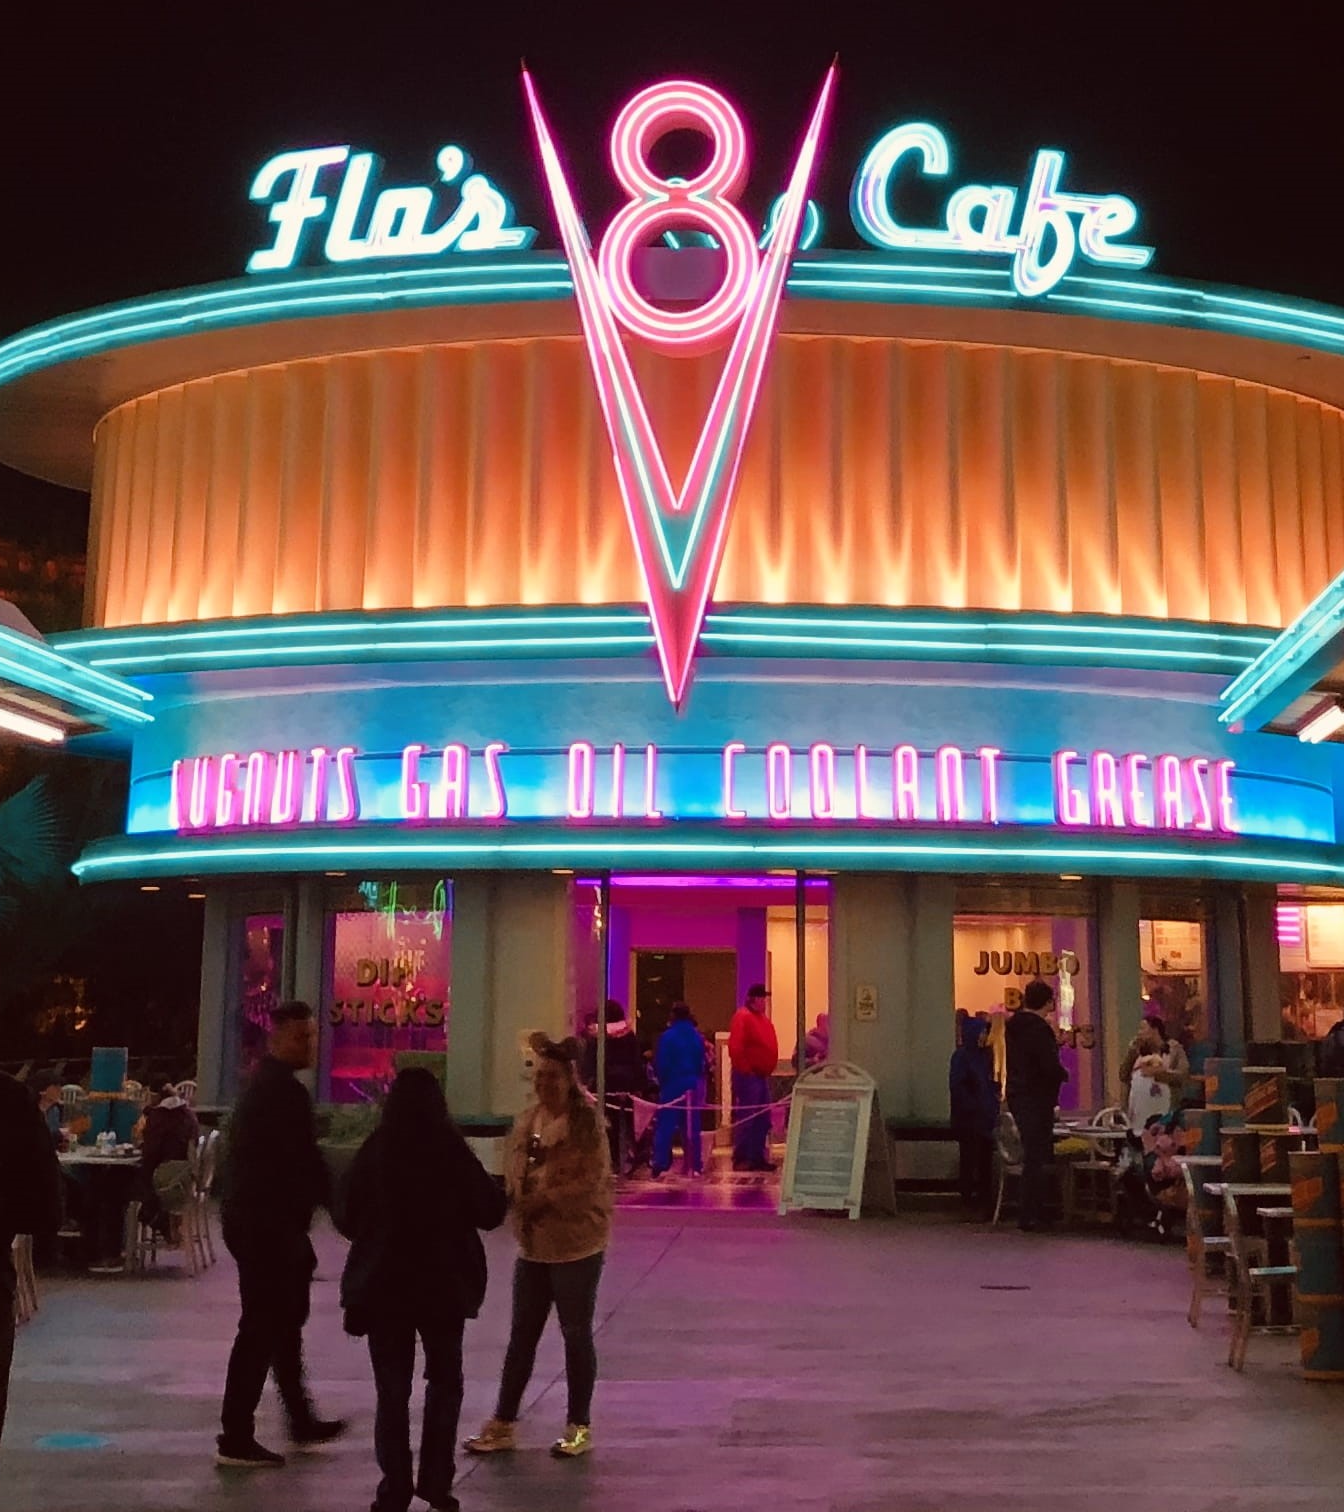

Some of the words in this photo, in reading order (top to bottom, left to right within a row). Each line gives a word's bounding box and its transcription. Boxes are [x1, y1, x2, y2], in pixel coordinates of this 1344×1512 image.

[246, 144, 538, 274] Flo's
[849, 121, 1155, 299] Cafe
[168, 746, 360, 833] LUGNUTS
[399, 742, 510, 822] GAS
[566, 741, 664, 821] OIL
[721, 741, 1002, 824] COOLANT
[1052, 749, 1241, 834] GREASE
[974, 950, 1081, 977] JUMBO
[330, 999, 446, 1028] STICKS
